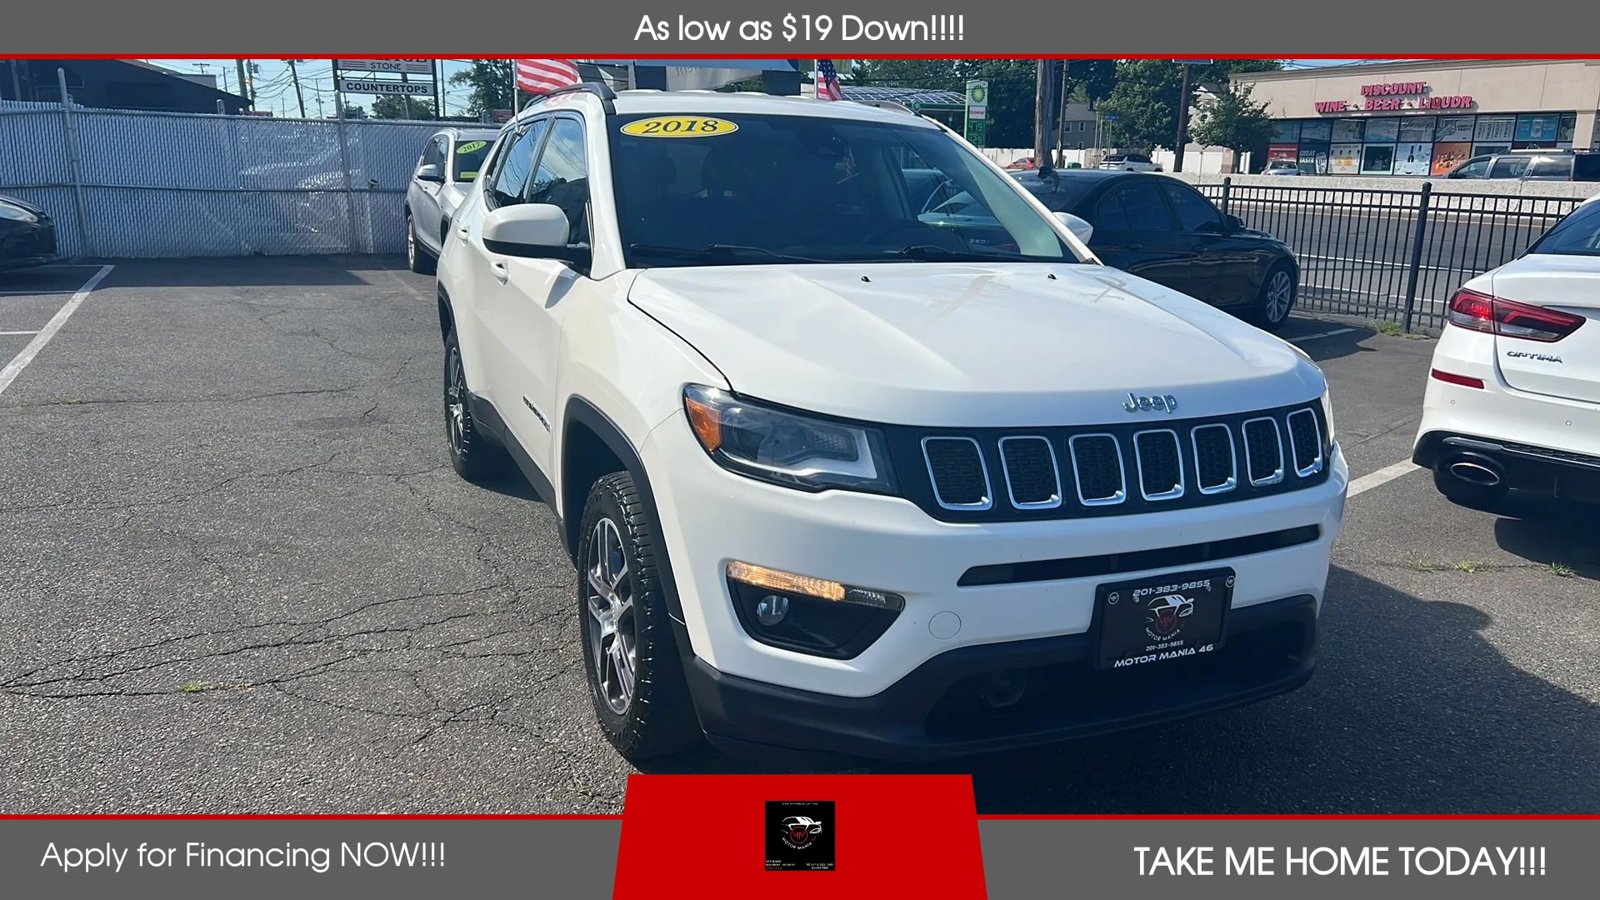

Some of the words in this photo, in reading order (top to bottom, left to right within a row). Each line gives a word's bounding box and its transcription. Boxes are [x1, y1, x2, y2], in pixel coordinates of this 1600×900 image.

[370, 62, 401, 70] STONE
[346, 82, 428, 94] COUNTERTOPS
[1360, 81, 1426, 96] DISCOUNT
[1315, 100, 1347, 113] WINE
[1364, 98, 1401, 111] BEER
[1419, 95, 1473, 110] LIQUOR
[642, 120, 719, 134] 2018
[1506, 350, 1563, 364] OPTIMA
[1122, 392, 1177, 414] Jeep
[1132, 579, 1211, 598] 201-383-9855
[1113, 654, 1157, 668] MOTOR
[1158, 647, 1196, 661] MANIA
[1198, 643, 1214, 653] 46
